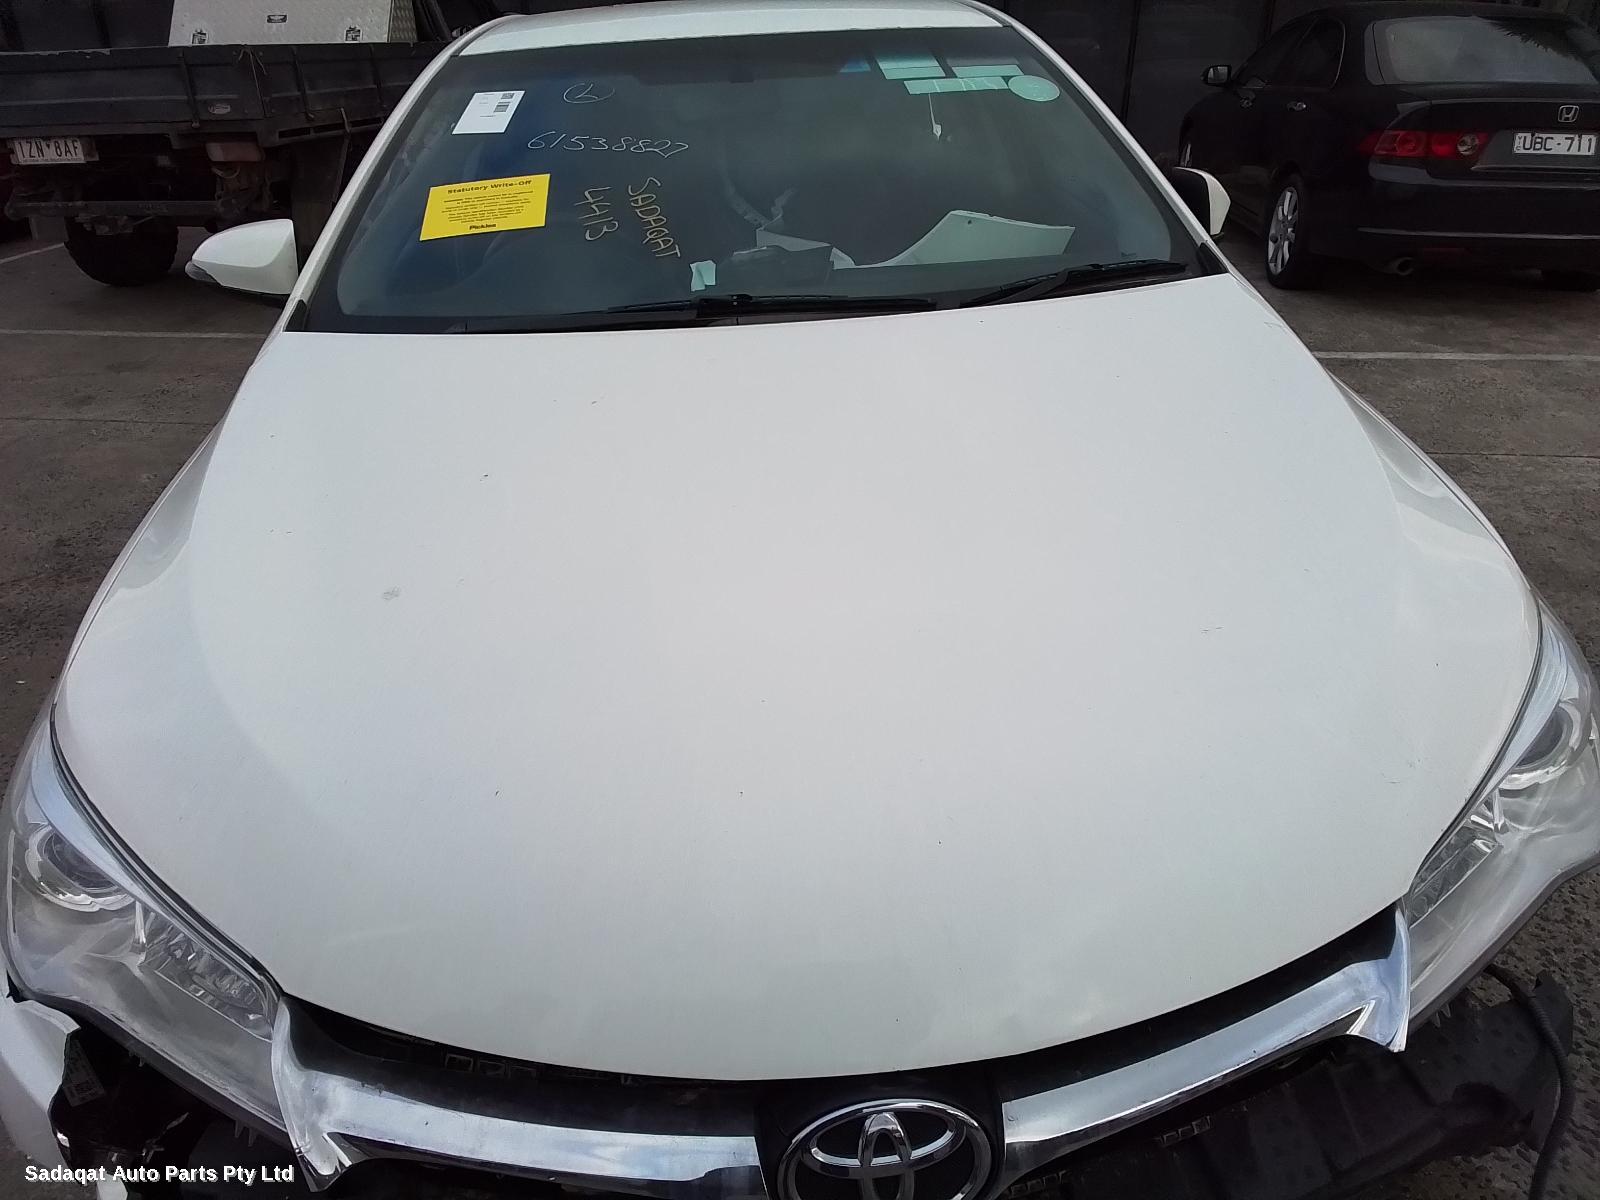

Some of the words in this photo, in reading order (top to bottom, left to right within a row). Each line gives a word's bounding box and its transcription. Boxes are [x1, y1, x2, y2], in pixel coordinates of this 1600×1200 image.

[447, 185, 489, 194] Statutory
[490, 179, 532, 189] Write-Off
[574, 186, 618, 240] 4413
[628, 176, 681, 257] SADAQAT
